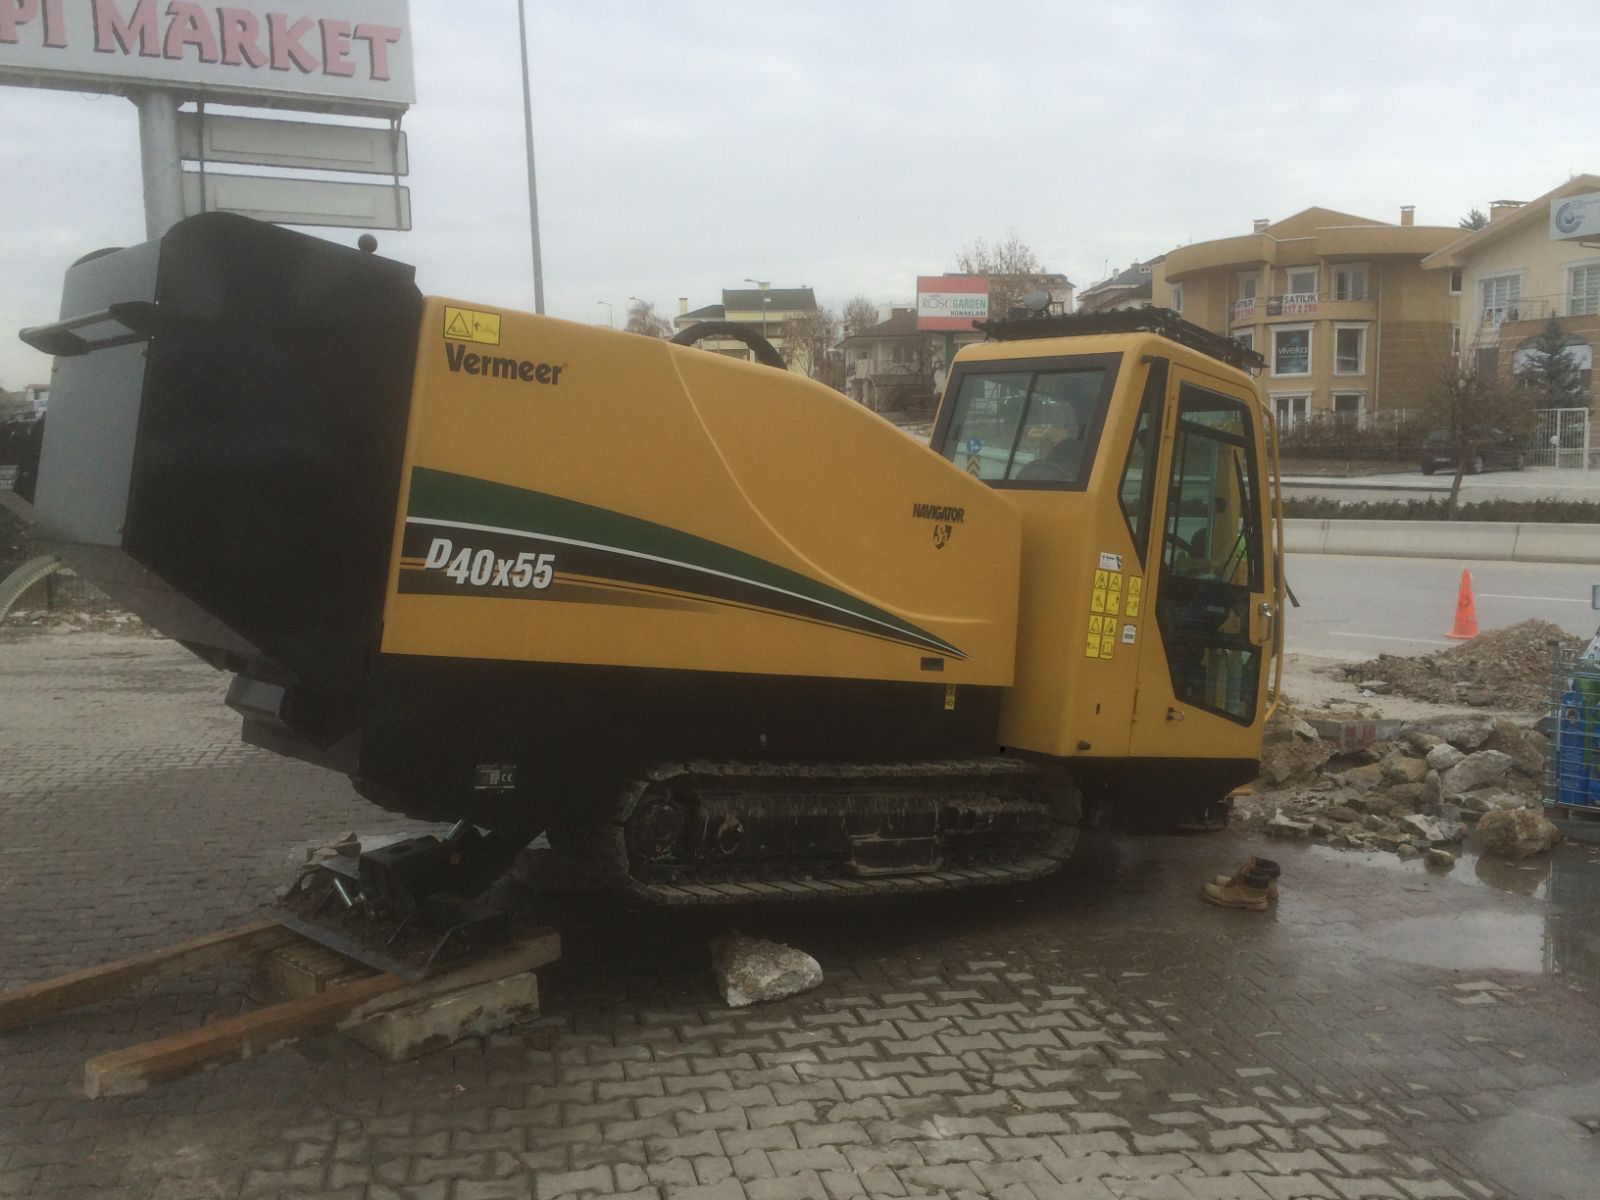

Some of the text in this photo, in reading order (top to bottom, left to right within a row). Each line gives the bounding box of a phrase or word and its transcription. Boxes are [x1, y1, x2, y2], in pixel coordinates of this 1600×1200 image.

[91, 0, 401, 81] MARKET
[952, 298, 986, 309] GARDEN
[444, 342, 563, 386] Vermeer
[912, 503, 965, 523] NAVIGATOR
[424, 537, 556, 590] D40x55
